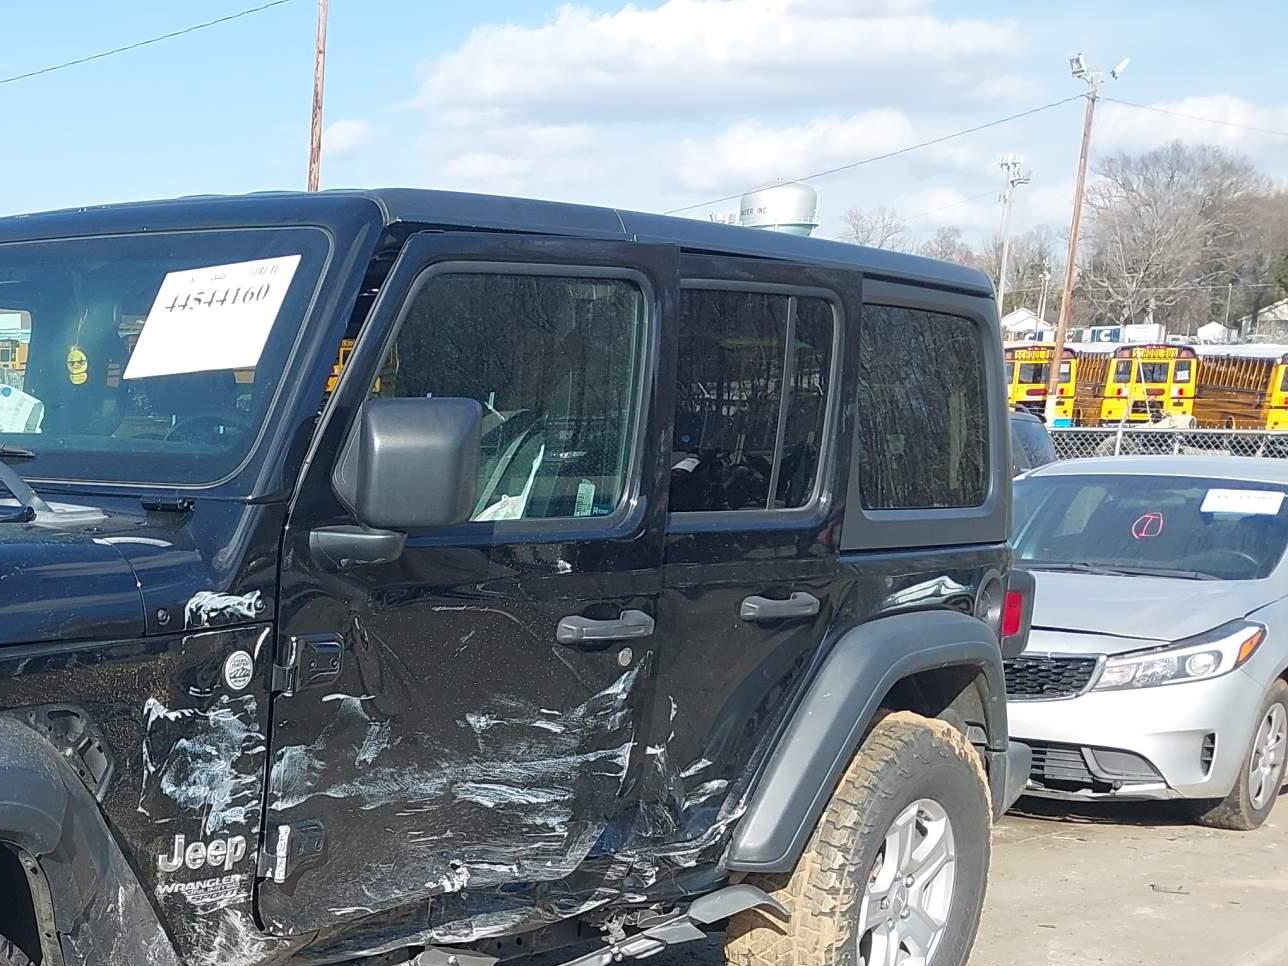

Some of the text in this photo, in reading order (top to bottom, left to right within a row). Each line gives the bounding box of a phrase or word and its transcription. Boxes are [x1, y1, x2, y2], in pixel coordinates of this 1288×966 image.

[164, 283, 271, 313] 44544160
[158, 833, 246, 872] Jeep
[157, 874, 242, 894] WRANGLER
